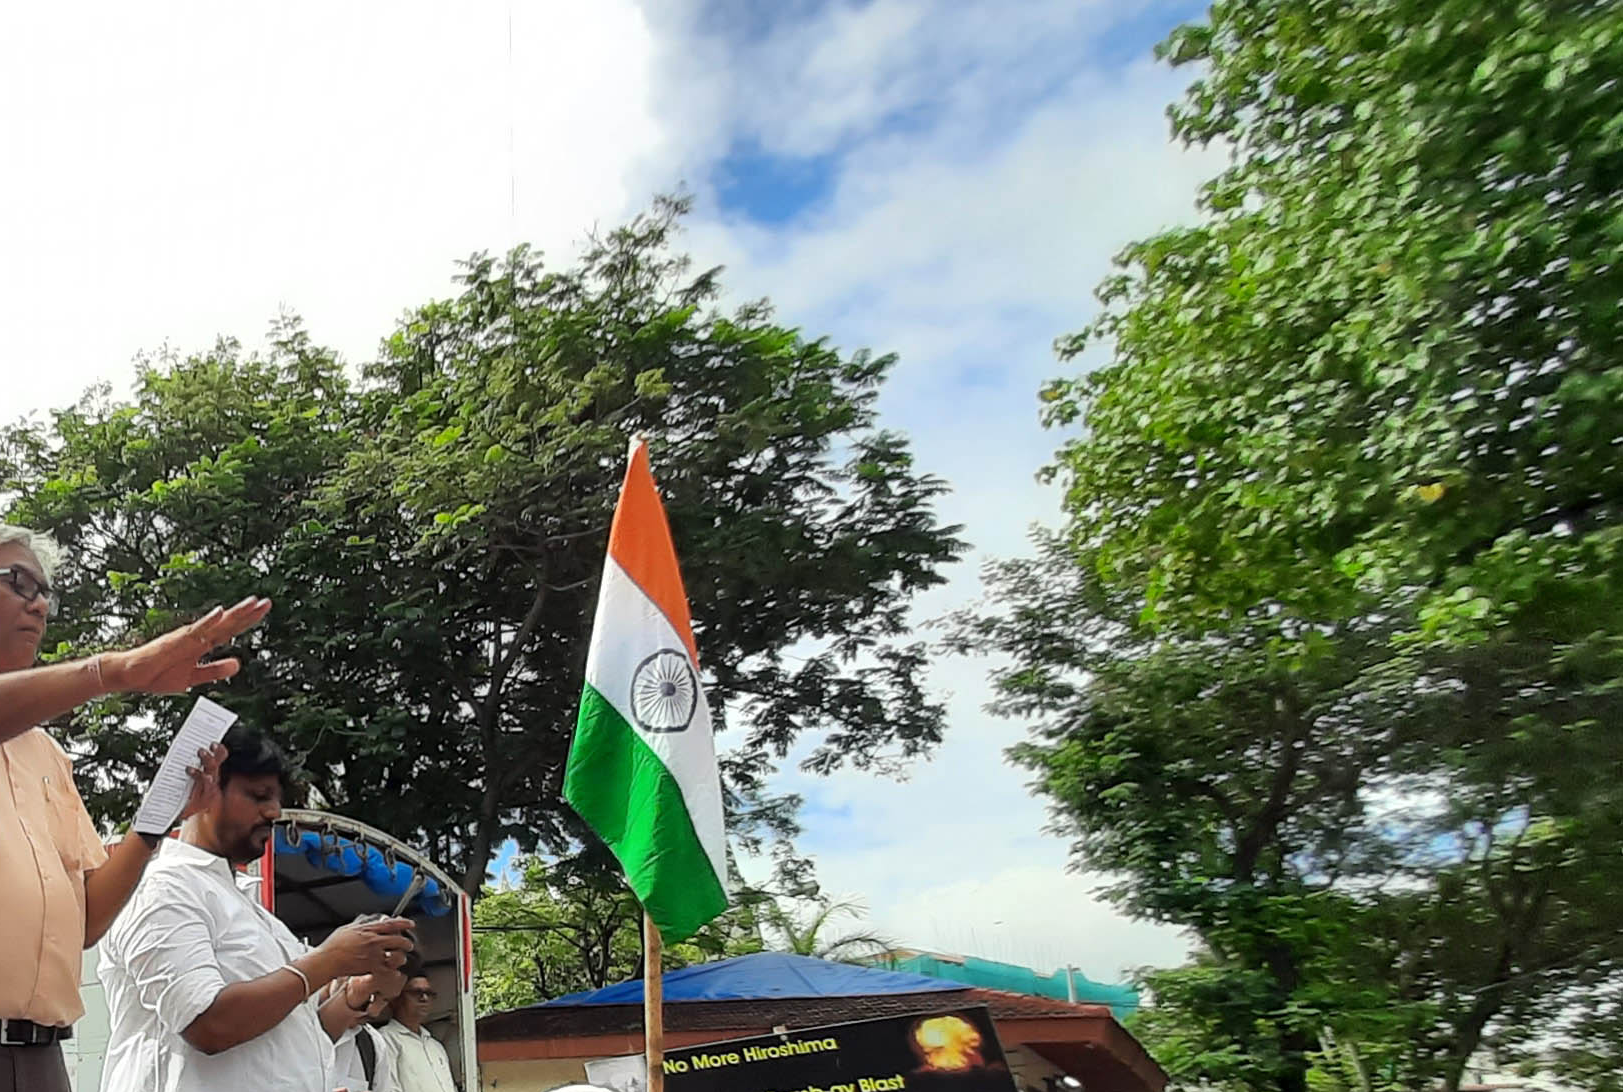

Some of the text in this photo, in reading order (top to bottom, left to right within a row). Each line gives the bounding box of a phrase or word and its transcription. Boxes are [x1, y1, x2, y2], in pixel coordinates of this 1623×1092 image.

[663, 1037, 838, 1075] No More Hiroshima
